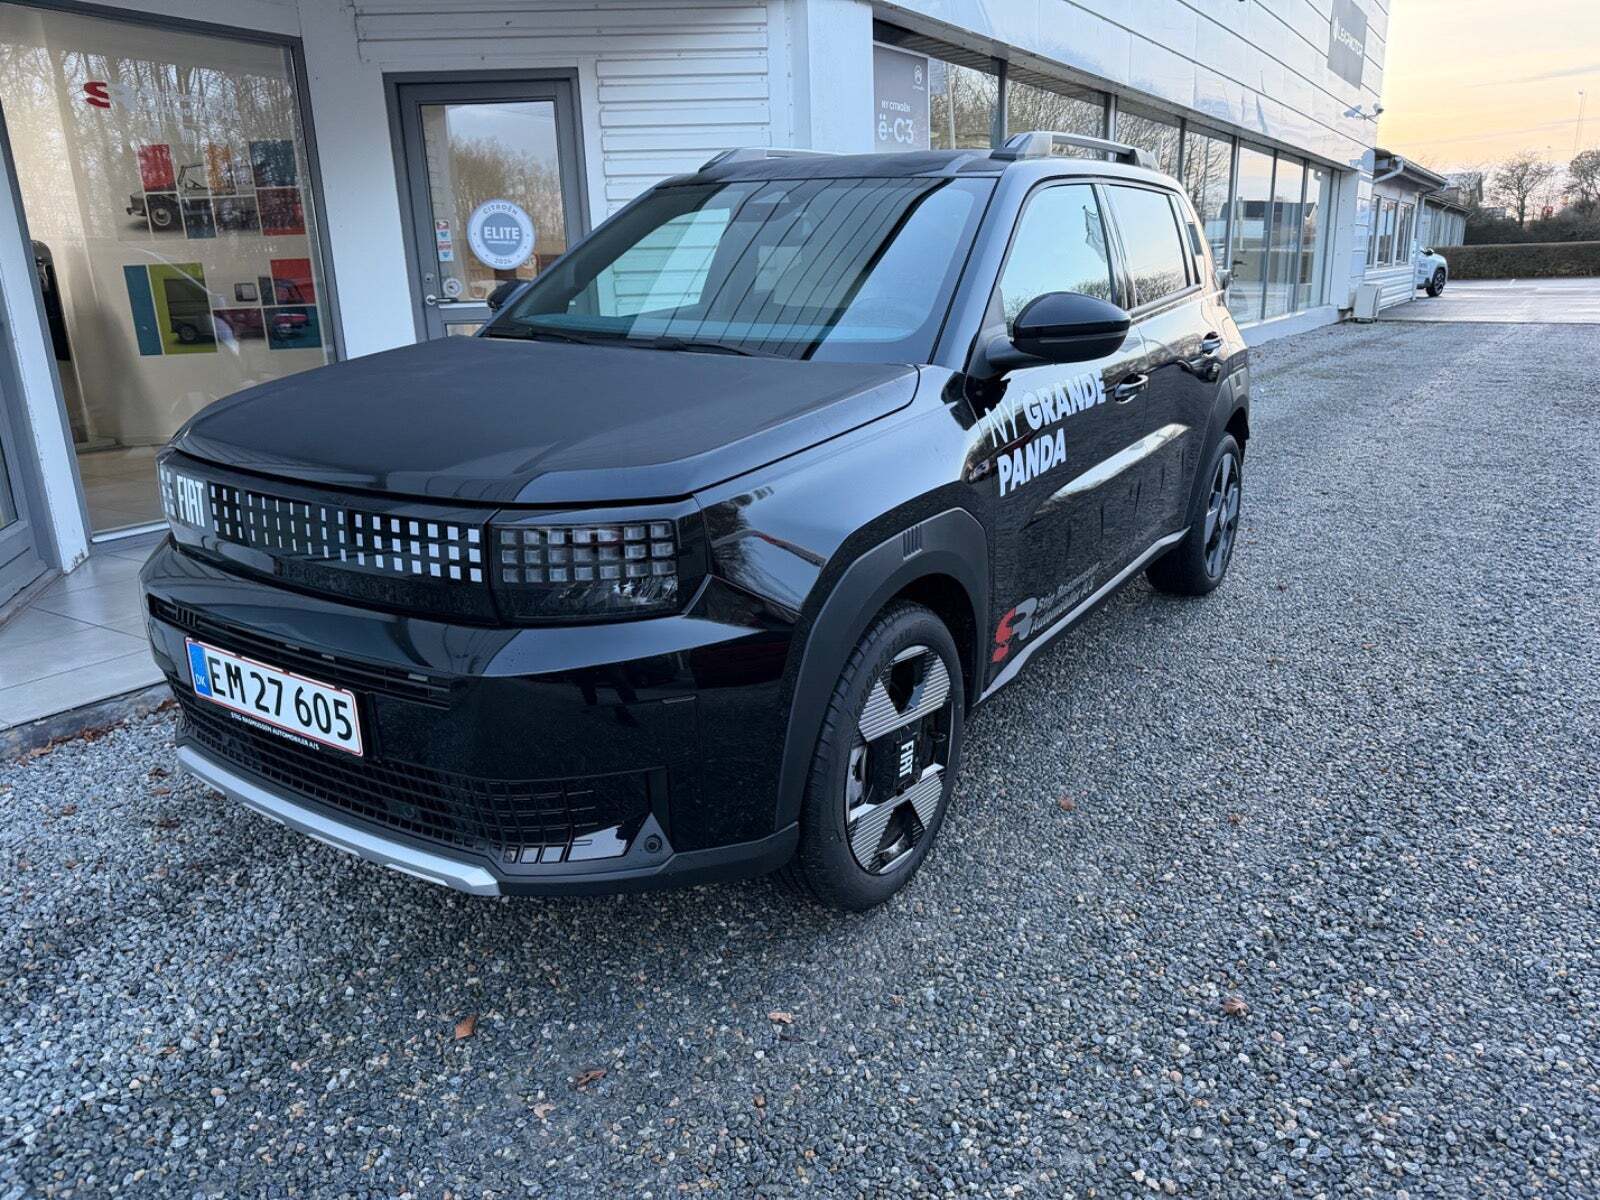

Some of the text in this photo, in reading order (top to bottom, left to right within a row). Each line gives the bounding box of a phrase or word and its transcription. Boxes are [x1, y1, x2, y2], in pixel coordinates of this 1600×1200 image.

[878, 113, 914, 144] ë-C3
[483, 227, 521, 240] ELITE
[985, 373, 1106, 448] NY GRANDE
[997, 428, 1066, 497] PANDA
[176, 474, 205, 528] FIAT
[195, 673, 206, 687] DK
[207, 655, 353, 742] EM 27 605
[899, 740, 914, 778] FIAT
